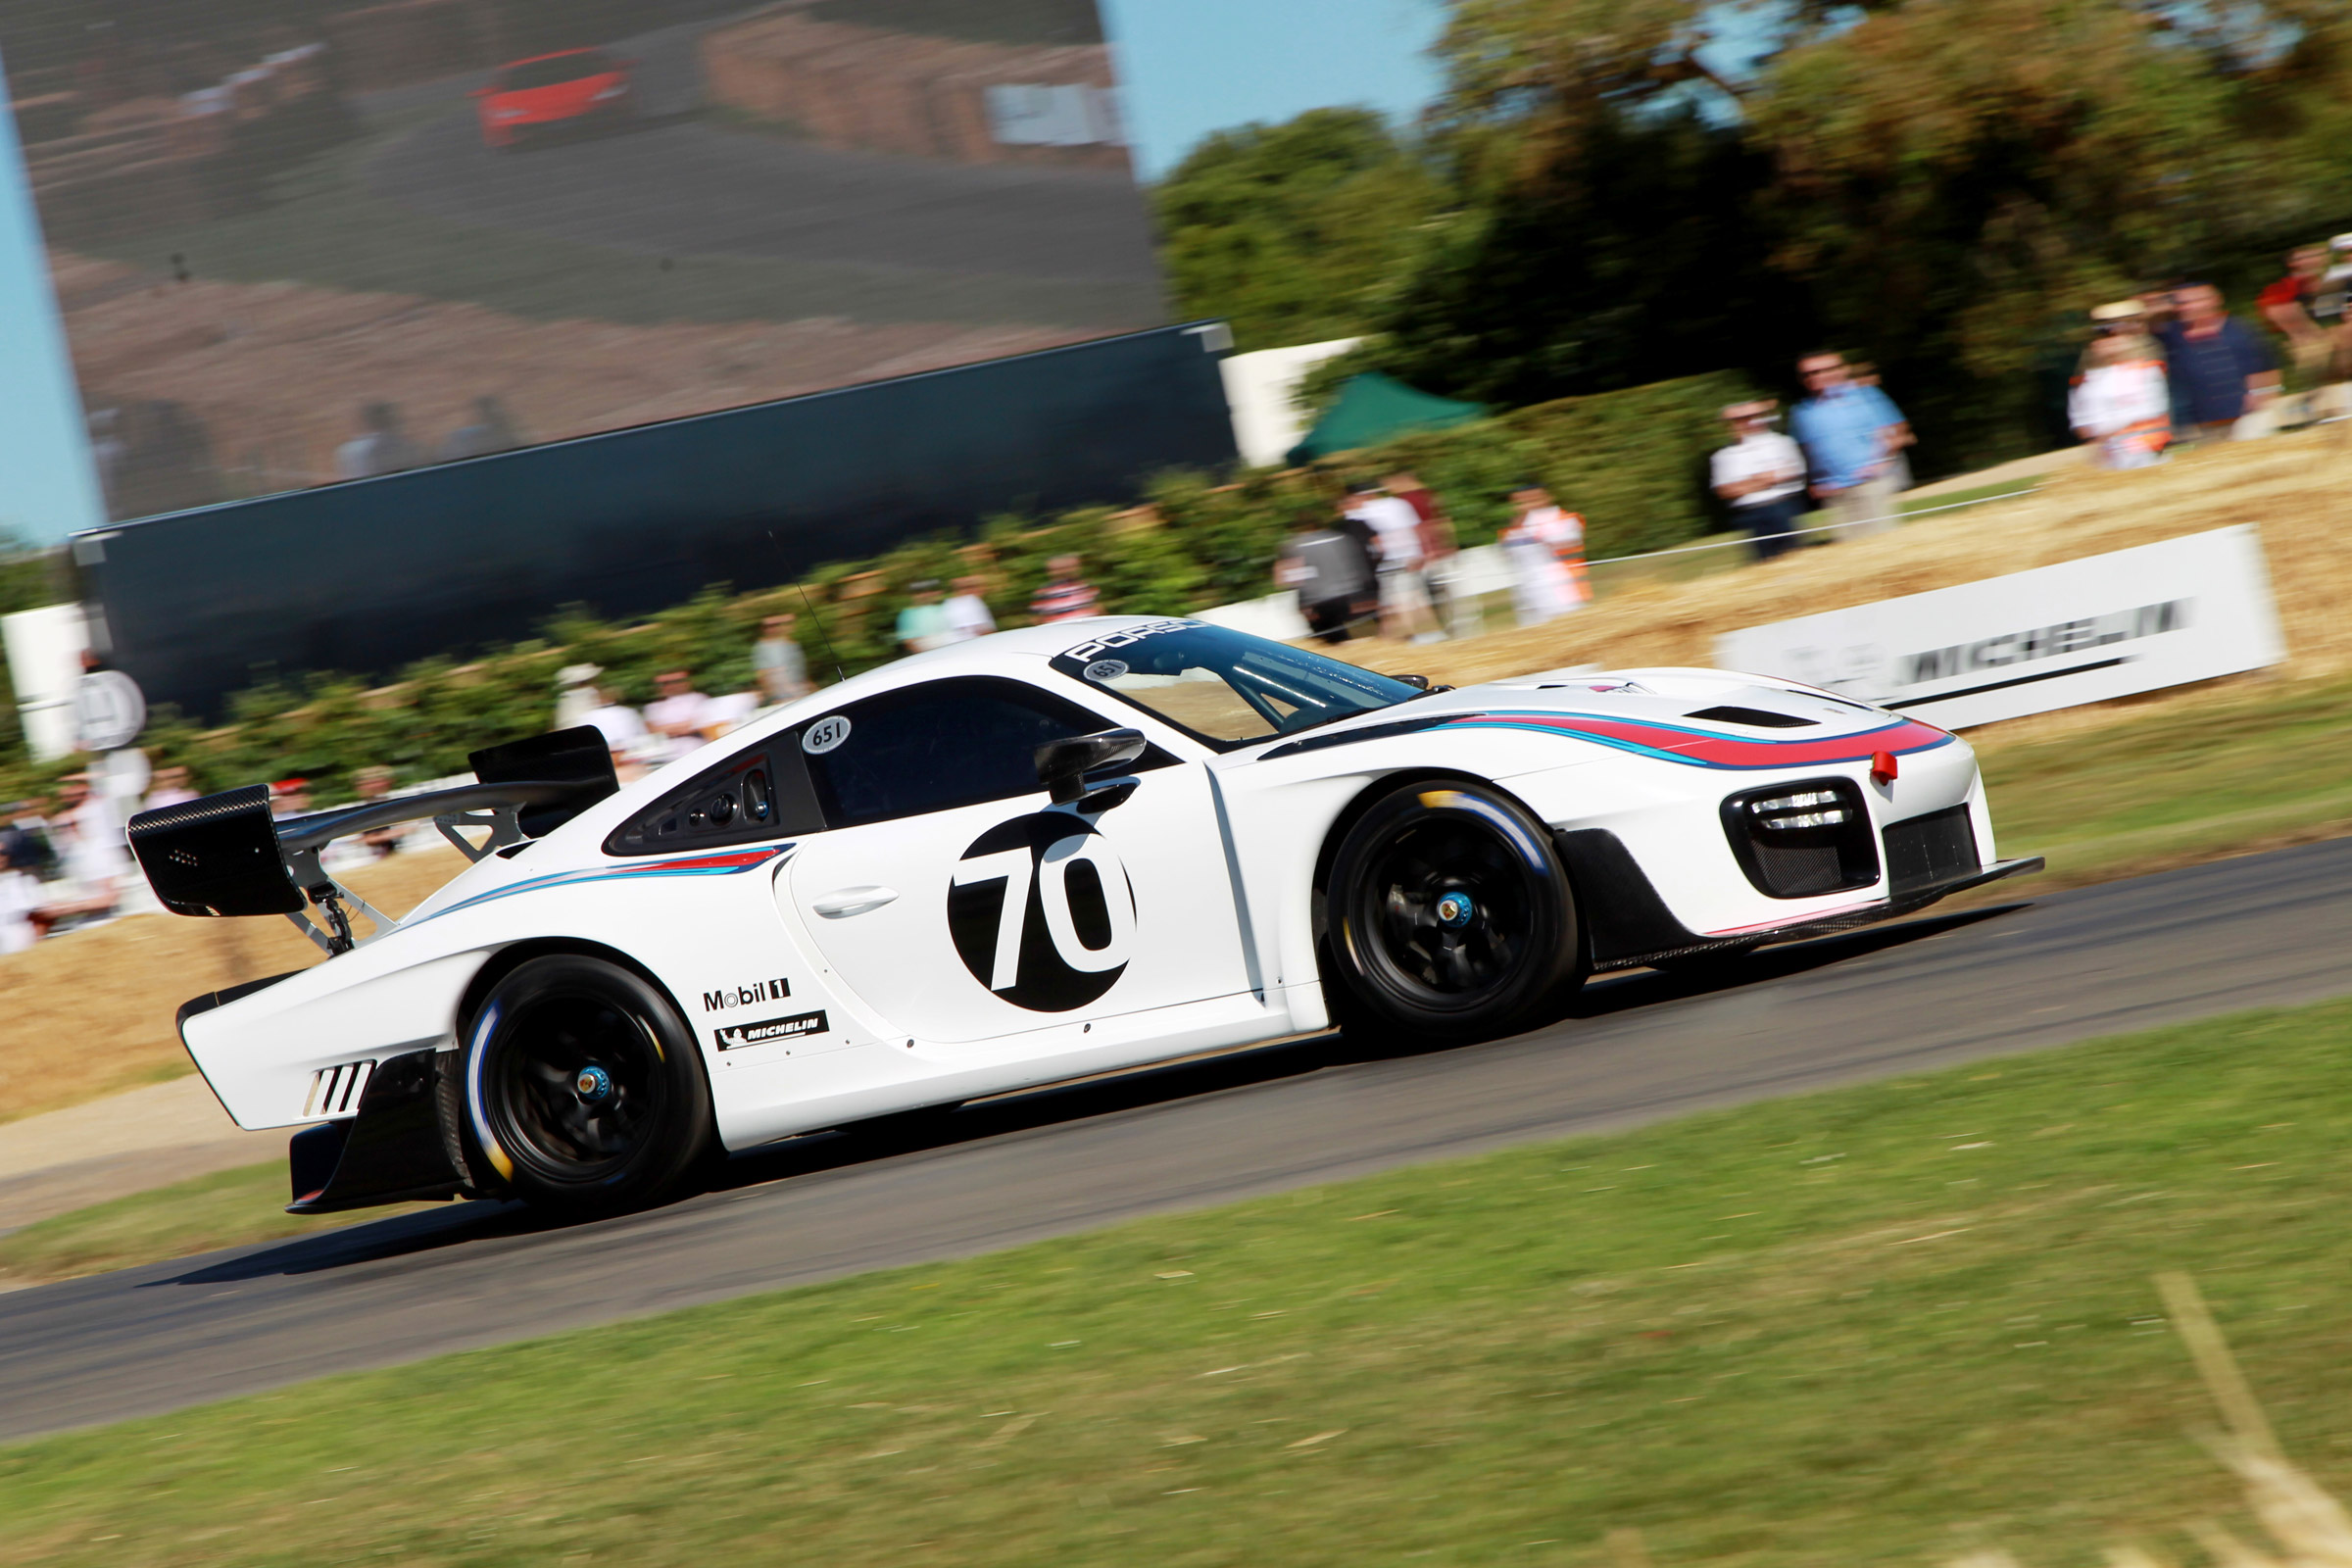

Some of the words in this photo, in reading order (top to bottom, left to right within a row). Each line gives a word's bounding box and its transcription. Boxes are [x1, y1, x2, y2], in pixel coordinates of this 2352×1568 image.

[1093, 662, 1122, 677] 651
[812, 721, 841, 746] 651
[953, 832, 1136, 992] 70
[703, 982, 766, 1011] Mobil
[747, 1017, 819, 1041] MICHELIN
